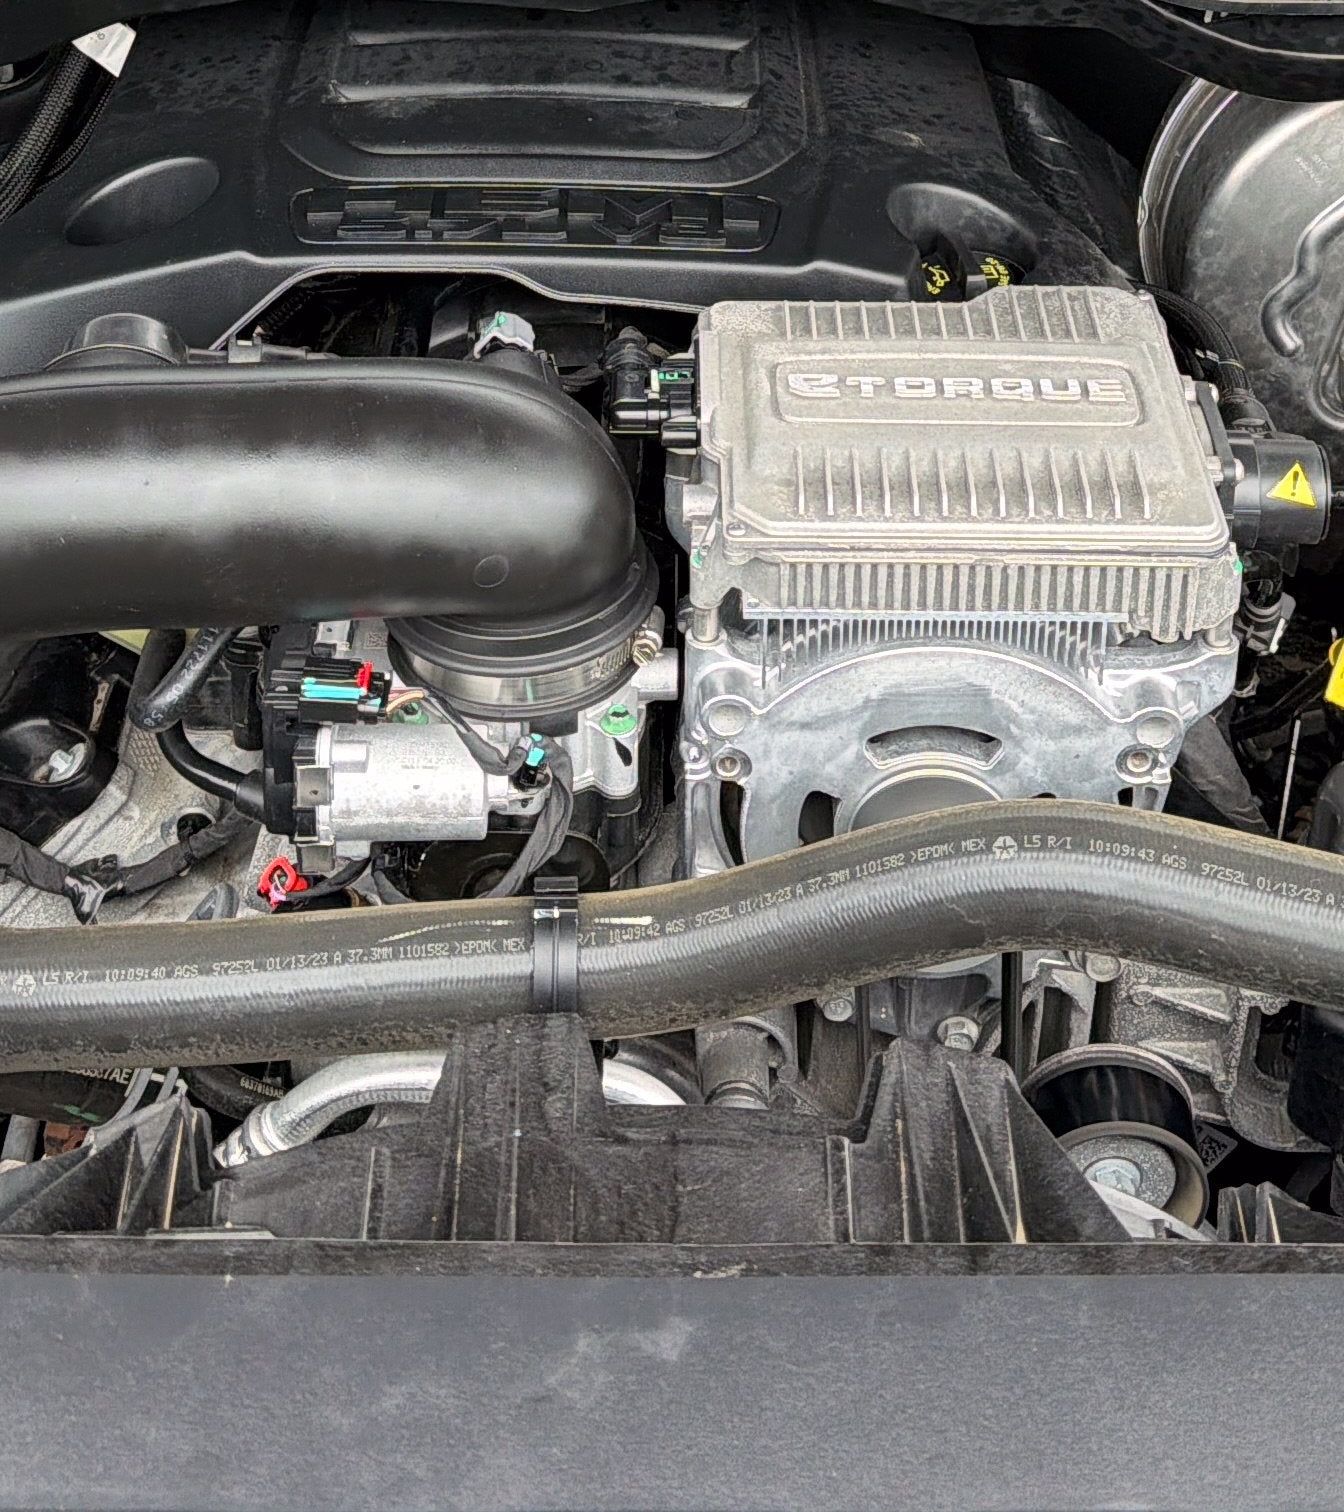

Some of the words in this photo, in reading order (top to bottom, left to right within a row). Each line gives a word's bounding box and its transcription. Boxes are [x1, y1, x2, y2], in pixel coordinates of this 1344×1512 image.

[665, 918, 687, 936] AGS
[694, 908, 735, 929] 97252L
[738, 885, 792, 916] 01/13/23
[855, 852, 906, 879] 1101582
[1088, 839, 1156, 863] 10:09:43
[1161, 853, 1189, 871] AGS
[1201, 862, 1250, 888] 97252L
[1256, 876, 1321, 904] 01/13/23
[1325, 893, 1336, 907] A
[105, 966, 167, 983] 10:09:40
[173, 964, 200, 979] AGS
[266, 951, 330, 971] 01/13/23
[347, 944, 394, 964] 37.3MM
[399, 942, 451, 961] 1101582
[503, 937, 526, 952] MEX
